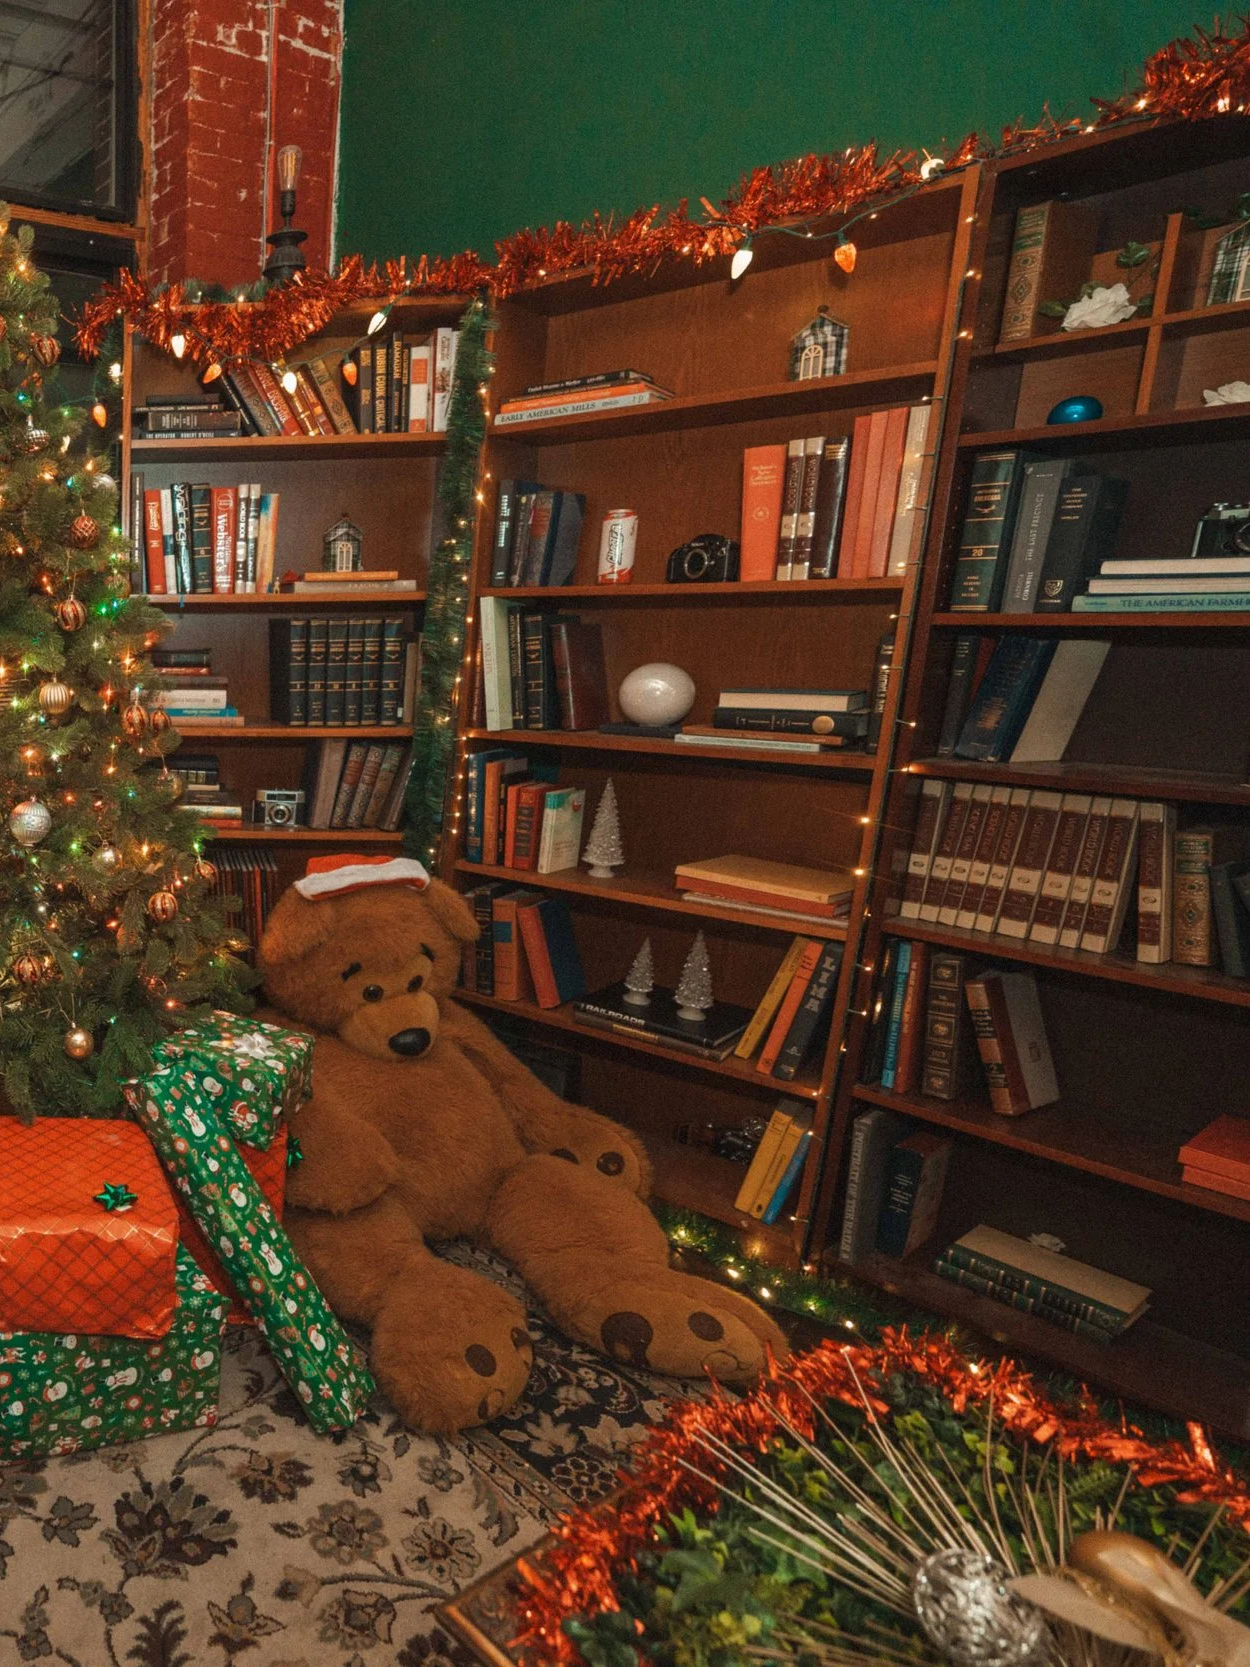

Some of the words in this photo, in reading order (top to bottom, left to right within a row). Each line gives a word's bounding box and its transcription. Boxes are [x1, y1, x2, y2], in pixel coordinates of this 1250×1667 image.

[376, 348, 386, 374] ROBIN
[376, 375, 386, 397] COOK
[376, 400, 386, 428] CRITICAL
[501, 414, 524, 422] EARLY
[526, 407, 568, 419] AMERICAN
[571, 402, 596, 412] MILLS
[1031, 493, 1045, 528] PRECINCT
[216, 512, 228, 573] Webster's
[1029, 529, 1038, 546] LAST
[1025, 549, 1035, 562] THE
[1148, 598, 1204, 607] AMERICAN
[804, 956, 836, 1012] LIMA
[585, 1004, 645, 1026] RAILROADS
